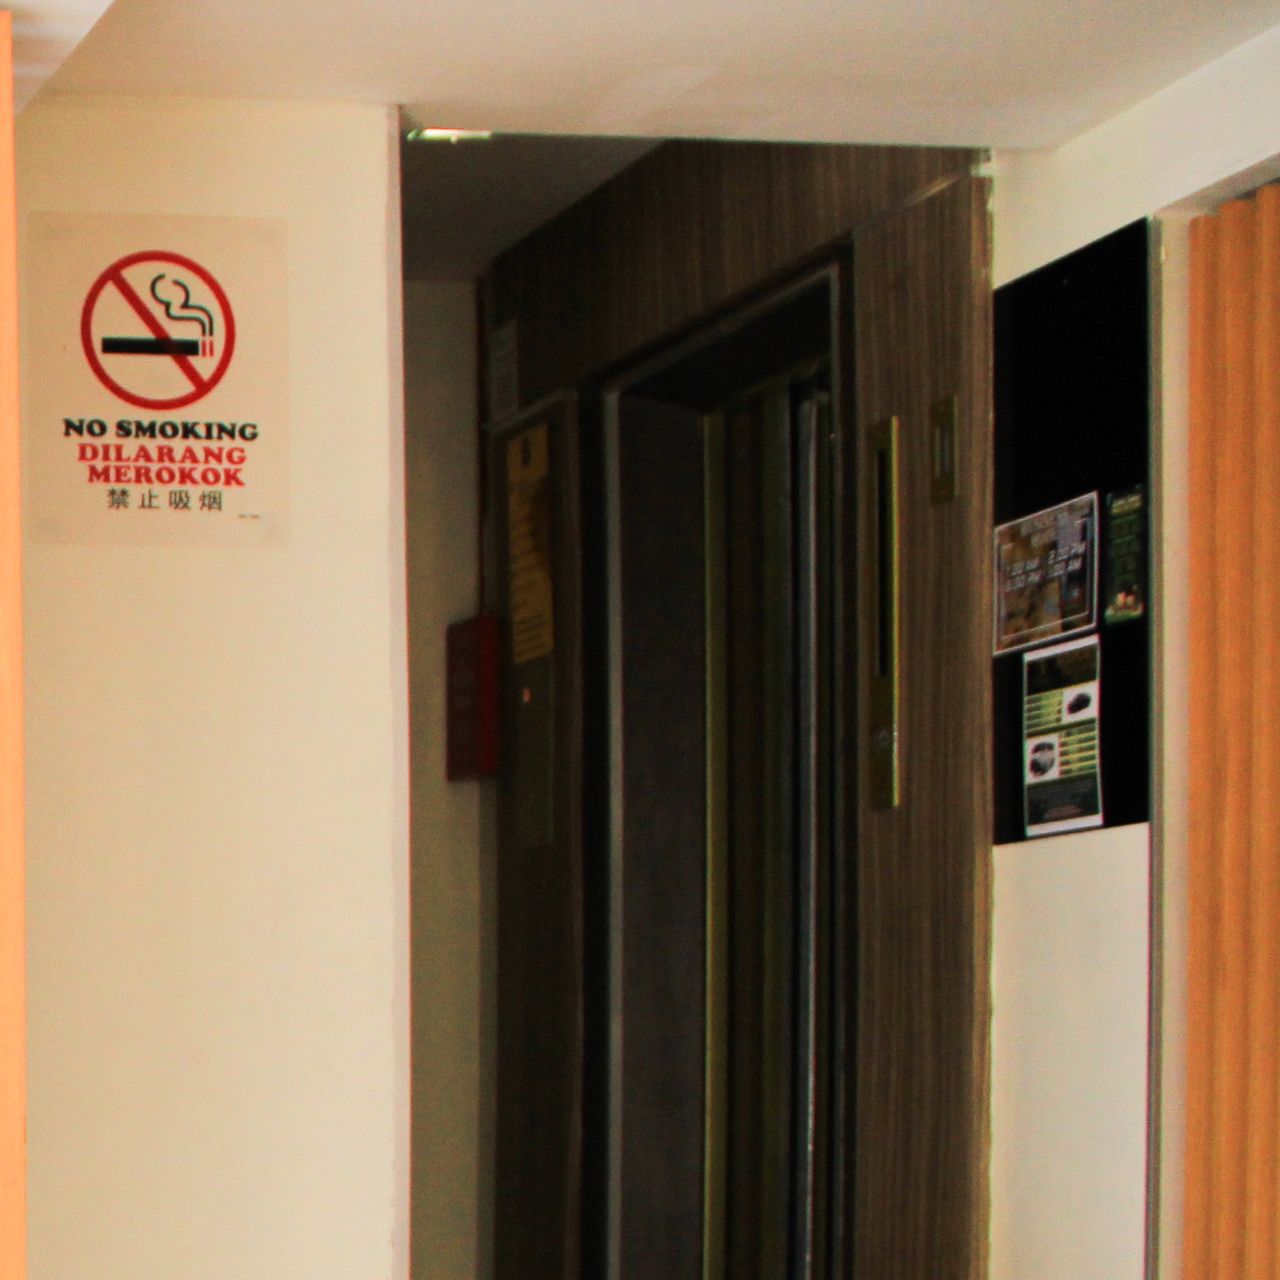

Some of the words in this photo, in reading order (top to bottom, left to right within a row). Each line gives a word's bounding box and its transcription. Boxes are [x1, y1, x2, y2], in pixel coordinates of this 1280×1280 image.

[62, 418, 107, 438] NO
[116, 420, 259, 441] SMOKING
[77, 443, 247, 465] DILARANG
[87, 464, 245, 487] MEROKOK
[107, 487, 222, 512] 禁止吸烟
